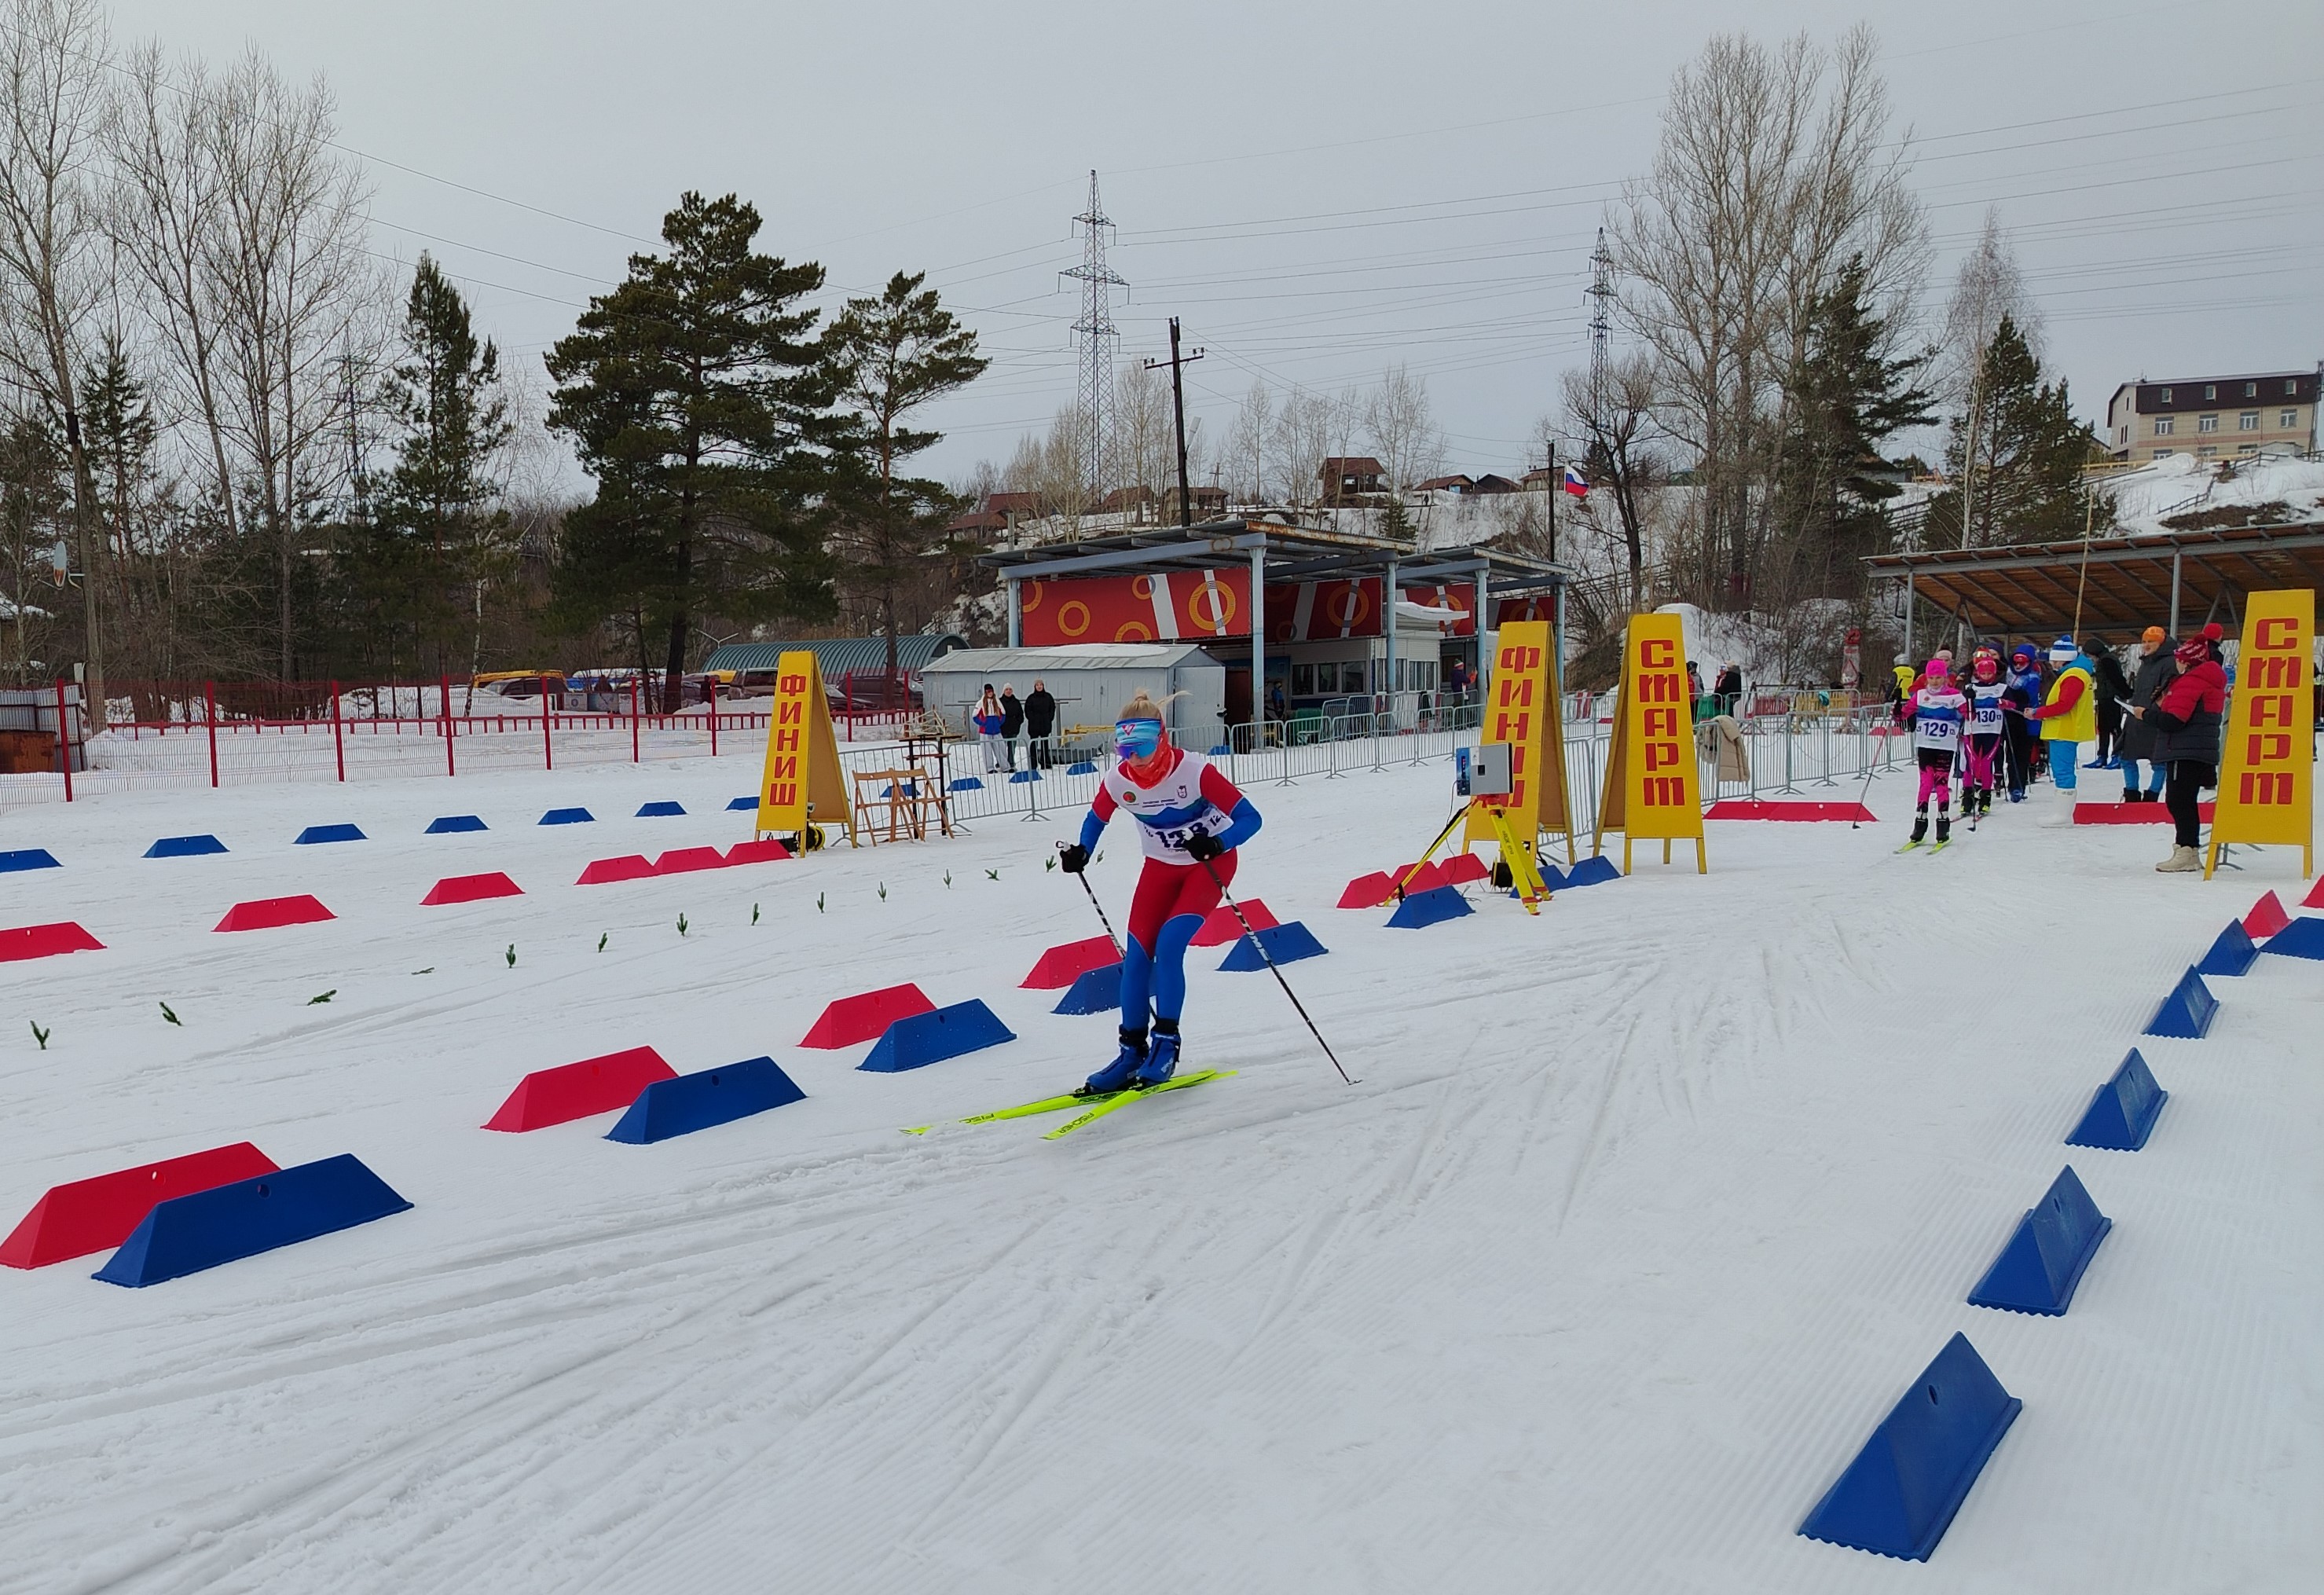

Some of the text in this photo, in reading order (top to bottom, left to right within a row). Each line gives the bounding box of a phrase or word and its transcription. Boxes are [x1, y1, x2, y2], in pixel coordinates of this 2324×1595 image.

[1976, 710, 1996, 724] 130
[1923, 721, 1948, 737] 129
[769, 674, 807, 806] ФИНИШ
